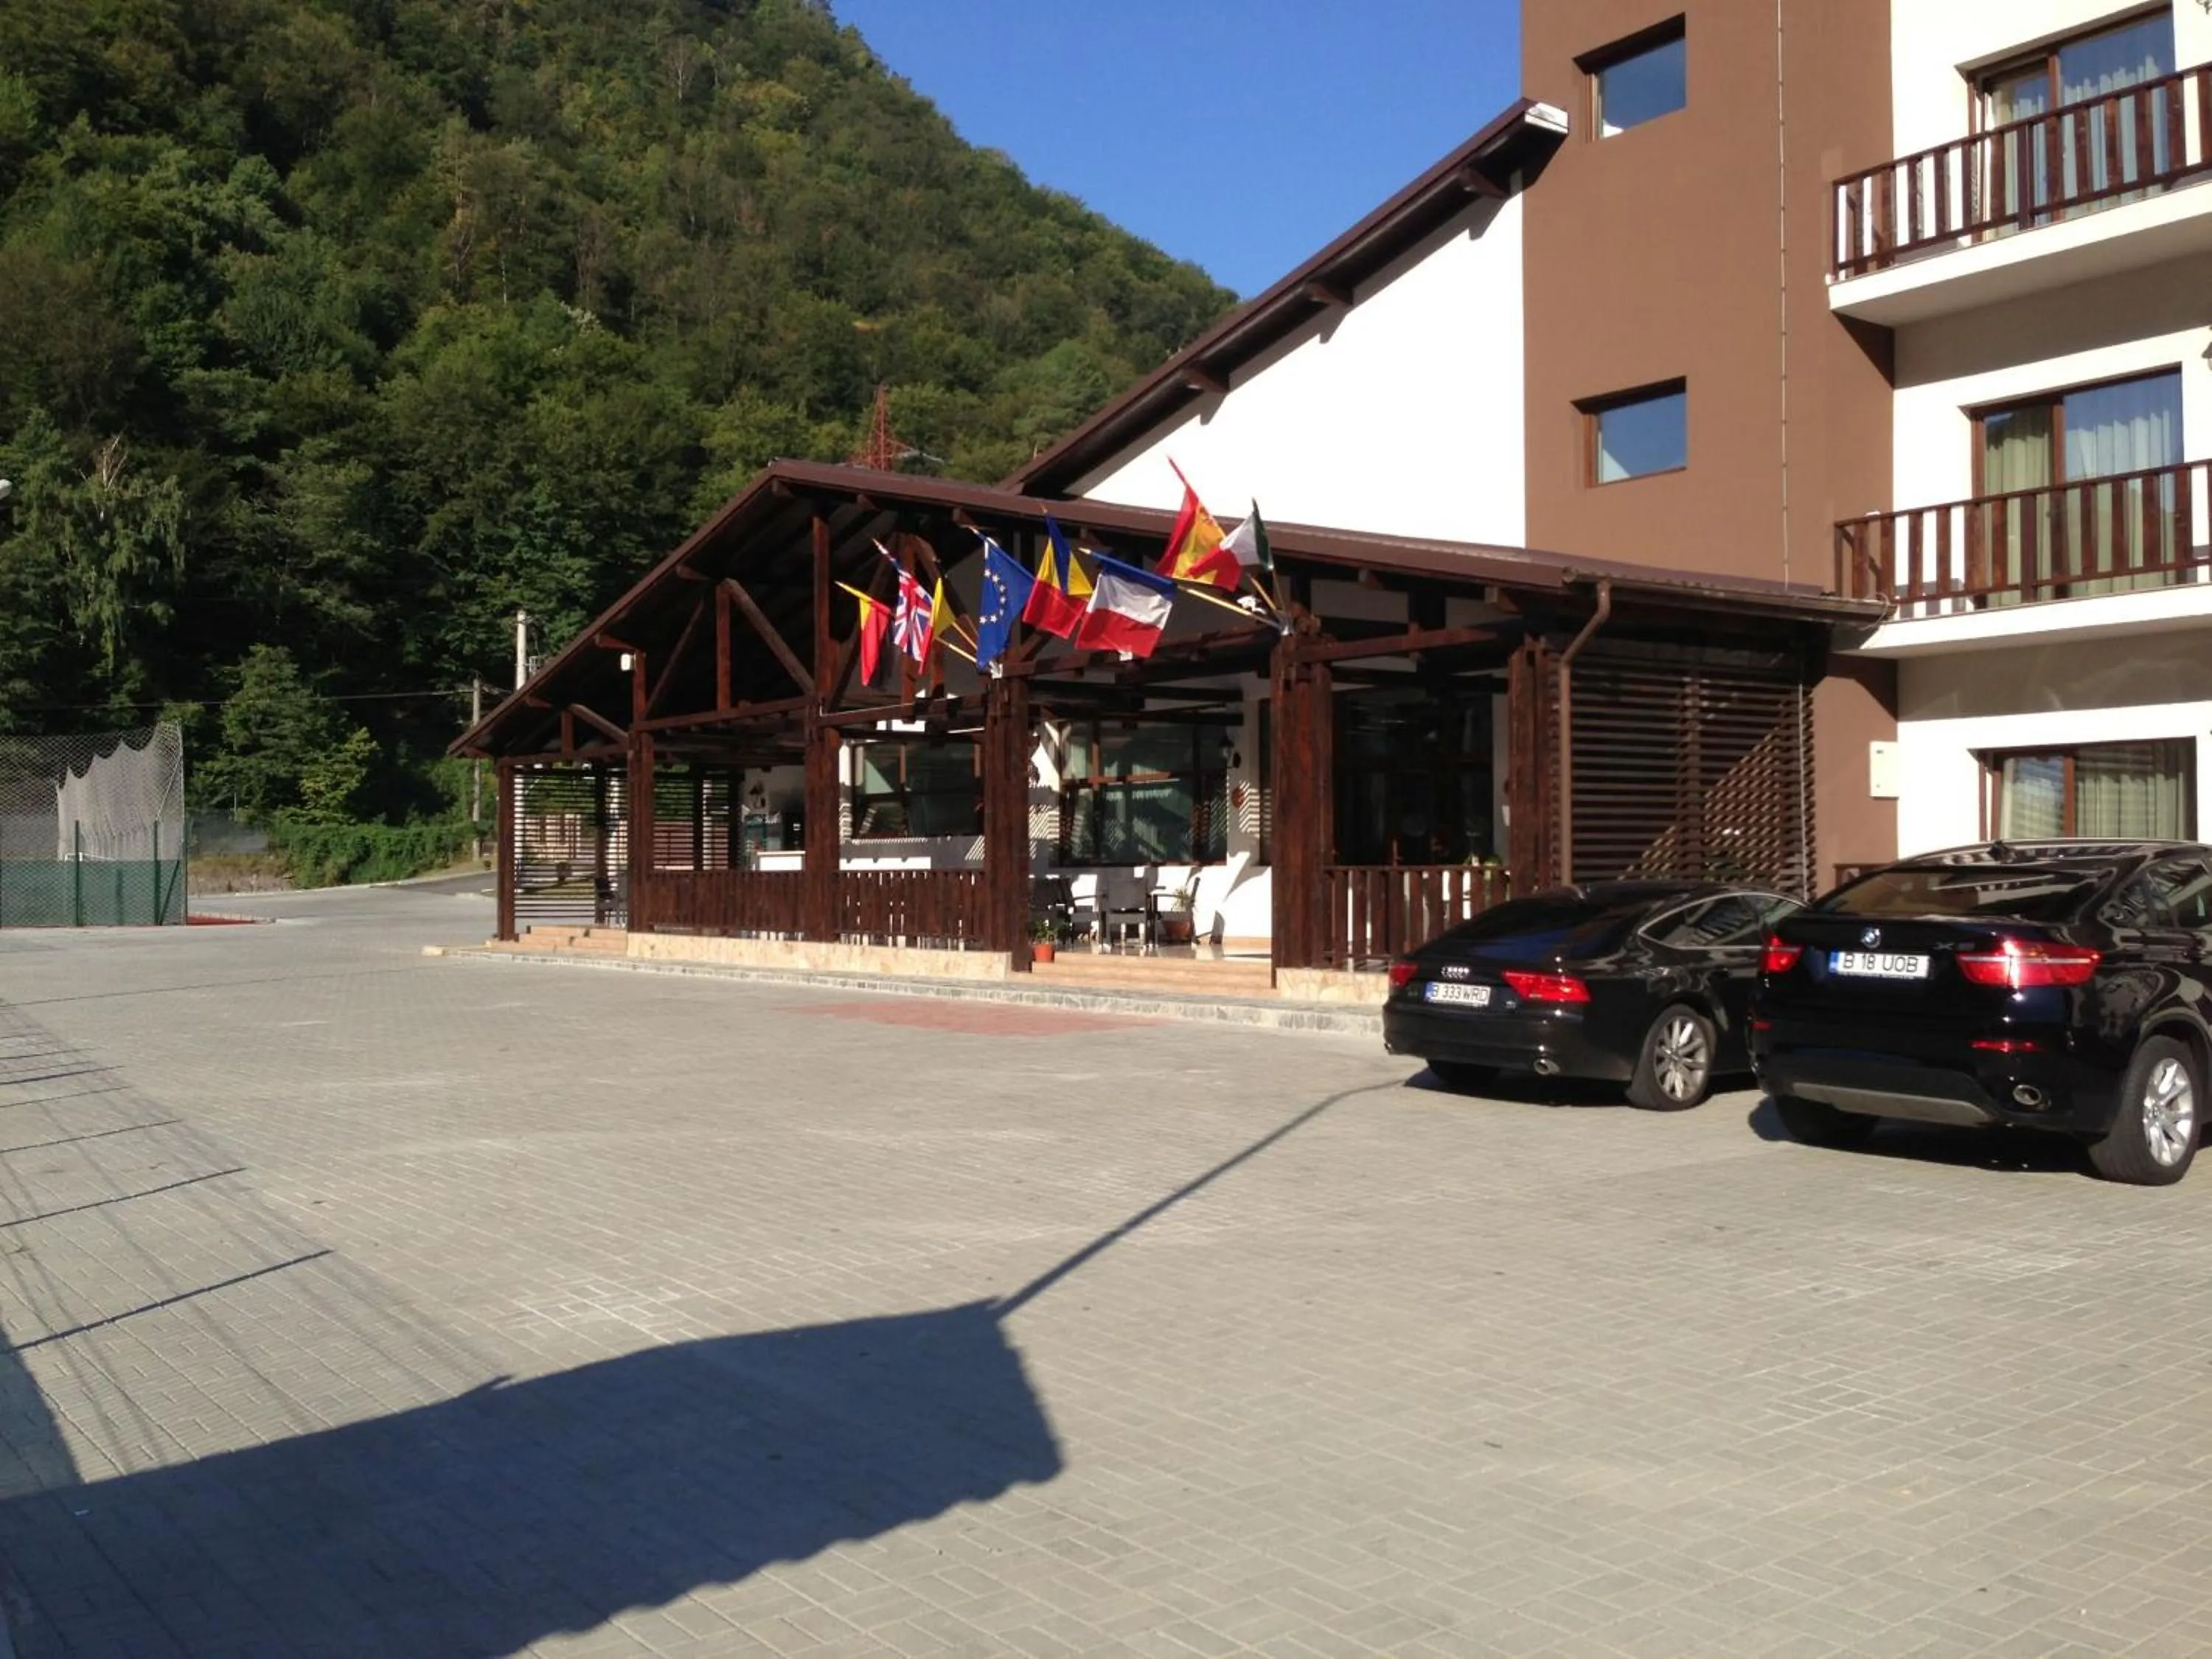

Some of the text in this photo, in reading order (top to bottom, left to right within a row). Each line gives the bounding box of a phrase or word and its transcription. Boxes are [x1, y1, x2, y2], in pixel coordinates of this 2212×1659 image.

[1861, 954, 1877, 970] 18
[1882, 955, 1919, 973] UOB
[1442, 985, 1461, 1000] 333
